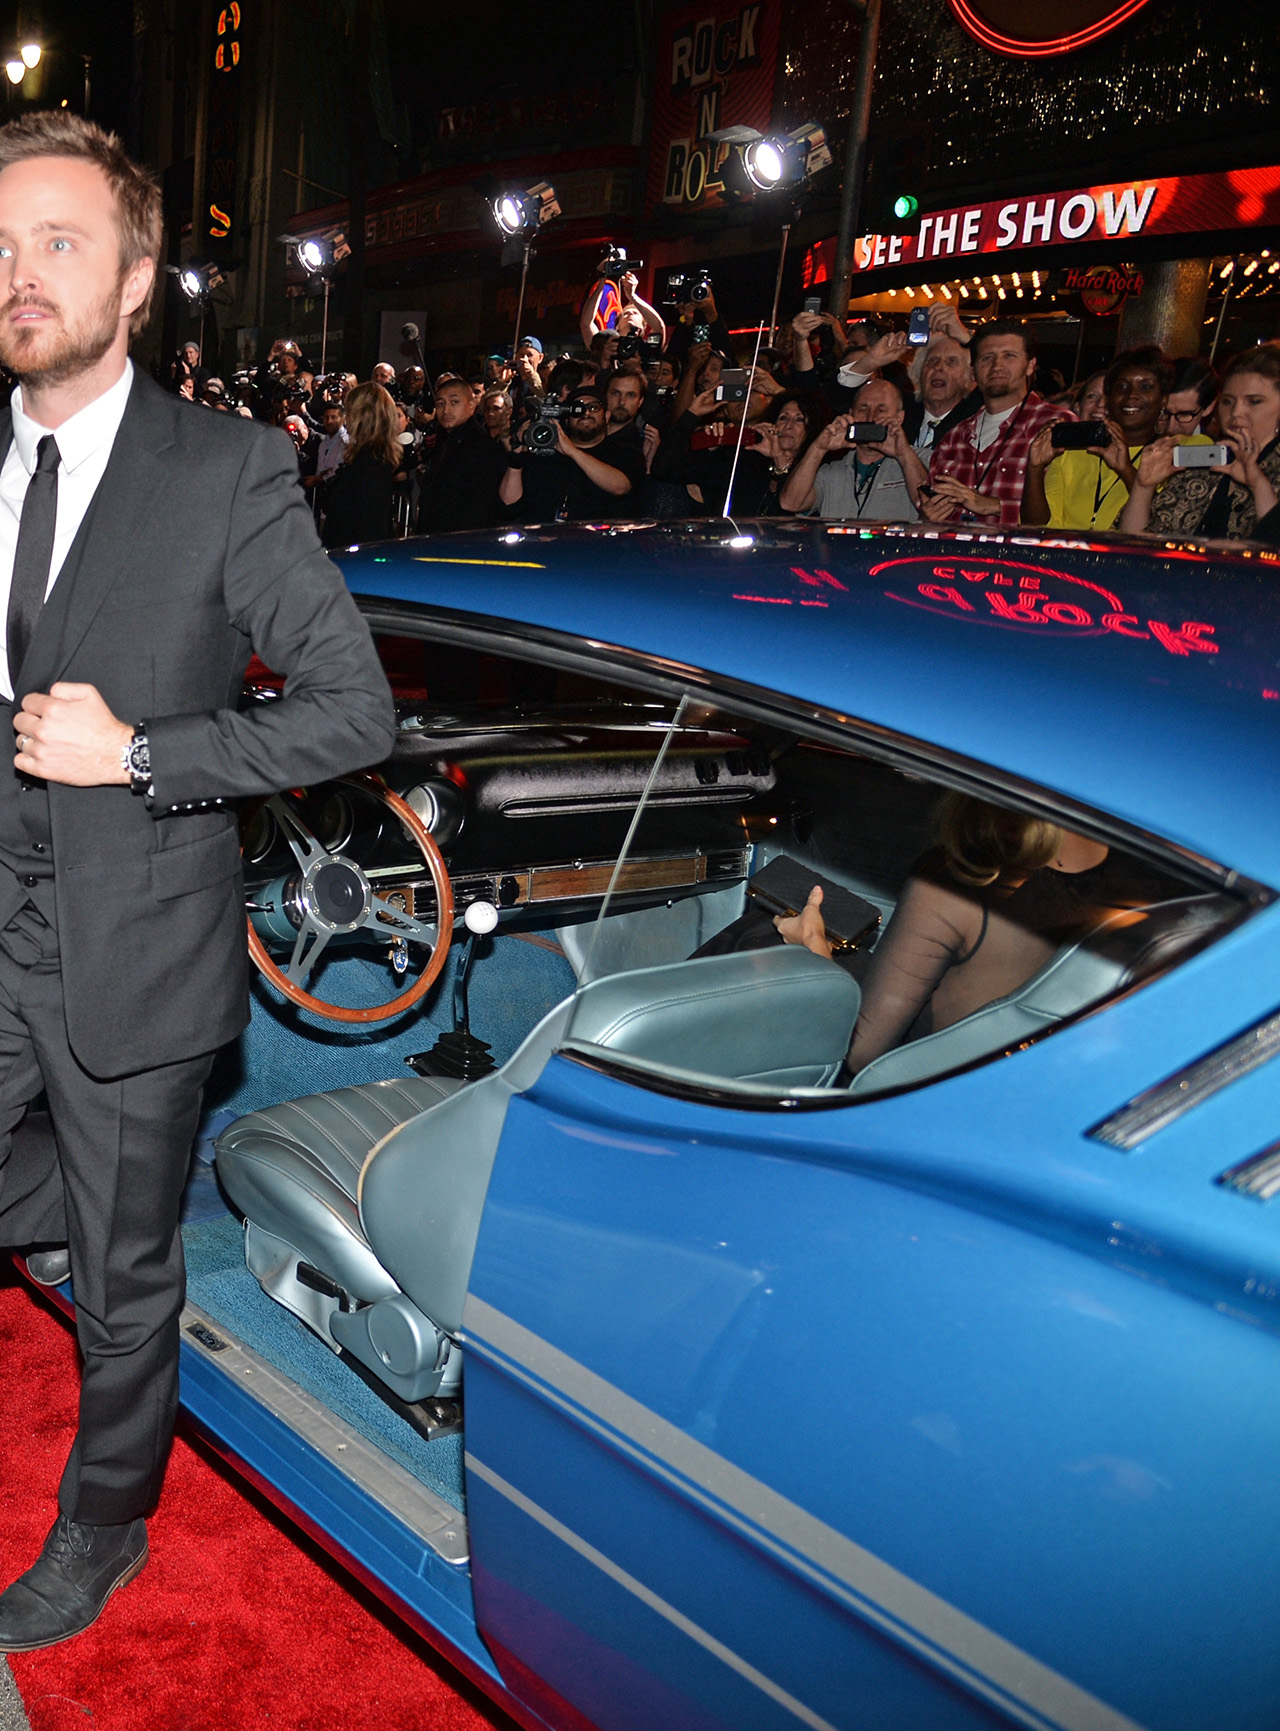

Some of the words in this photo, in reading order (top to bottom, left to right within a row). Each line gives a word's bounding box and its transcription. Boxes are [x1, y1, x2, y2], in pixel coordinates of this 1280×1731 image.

[671, 5, 761, 87] ROCK
[663, 138, 727, 204] ROL
[859, 234, 903, 270] SEE
[916, 209, 982, 258] THE
[995, 186, 1157, 247] SHOW
[1065, 268, 1107, 290] Hard
[1106, 270, 1144, 295] Rock
